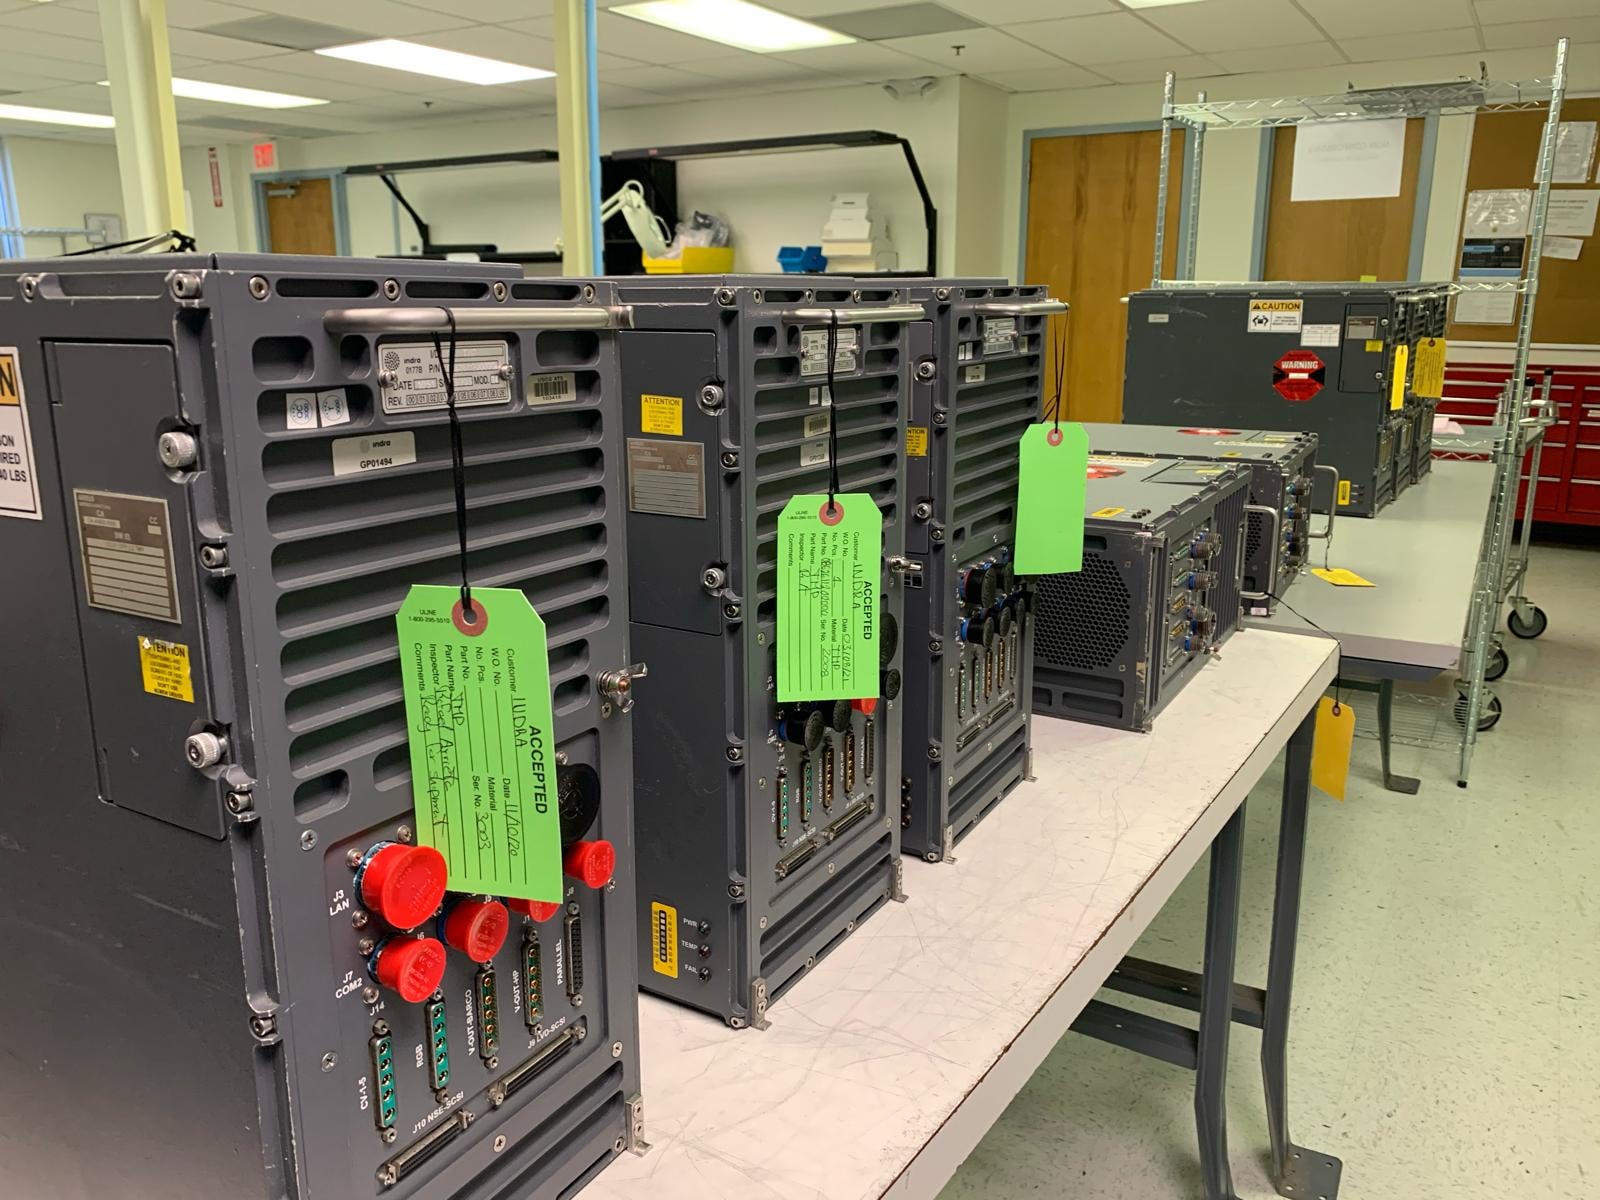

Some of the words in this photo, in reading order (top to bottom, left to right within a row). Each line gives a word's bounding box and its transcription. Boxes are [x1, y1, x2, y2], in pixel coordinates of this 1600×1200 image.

[1261, 302, 1300, 310] CAUTION
[428, 364, 440, 373] P/N
[1281, 360, 1318, 369] WARNING
[393, 381, 412, 391] DATE
[474, 376, 490, 384] MOD.
[388, 397, 402, 406] REV.
[644, 397, 680, 406] ATTENTION
[372, 440, 391, 448] indra
[360, 458, 392, 469] GP01494
[9, 470, 27, 482] LBS
[863, 580, 872, 640] ACCEPTED
[143, 642, 186, 658] TENTION
[444, 644, 453, 662] Part
[460, 645, 469, 664] Part
[414, 642, 426, 692] Comments
[429, 643, 440, 686] Inspector
[506, 648, 517, 694] Customer
[446, 665, 456, 692] Name
[462, 666, 470, 682] No.
[478, 665, 486, 684] Pcs.
[494, 671, 502, 687] No.
[528, 725, 548, 814] ACCEPTED
[472, 775, 480, 792] Ser.
[502, 778, 510, 798] Date
[474, 794, 482, 810] No.
[488, 776, 498, 812] Material
[333, 889, 344, 902] J3
[329, 898, 350, 916] LAN
[682, 918, 698, 928] PWR
[681, 940, 698, 950] TEMP
[342, 970, 354, 984] J7
[684, 964, 698, 974] FAIL
[335, 978, 362, 999] COM2
[512, 970, 521, 1014] V-OUT-HP
[369, 1001, 385, 1017] J14
[464, 988, 476, 1056] V-OUT-BARCO
[527, 1037, 536, 1049] J9
[536, 1016, 566, 1042] LVD-SCSI
[415, 1044, 424, 1068] RGB
[358, 1076, 368, 1110] CV-1-5
[412, 1118, 427, 1134] J10
[427, 1090, 464, 1123] NSE-SCSI
